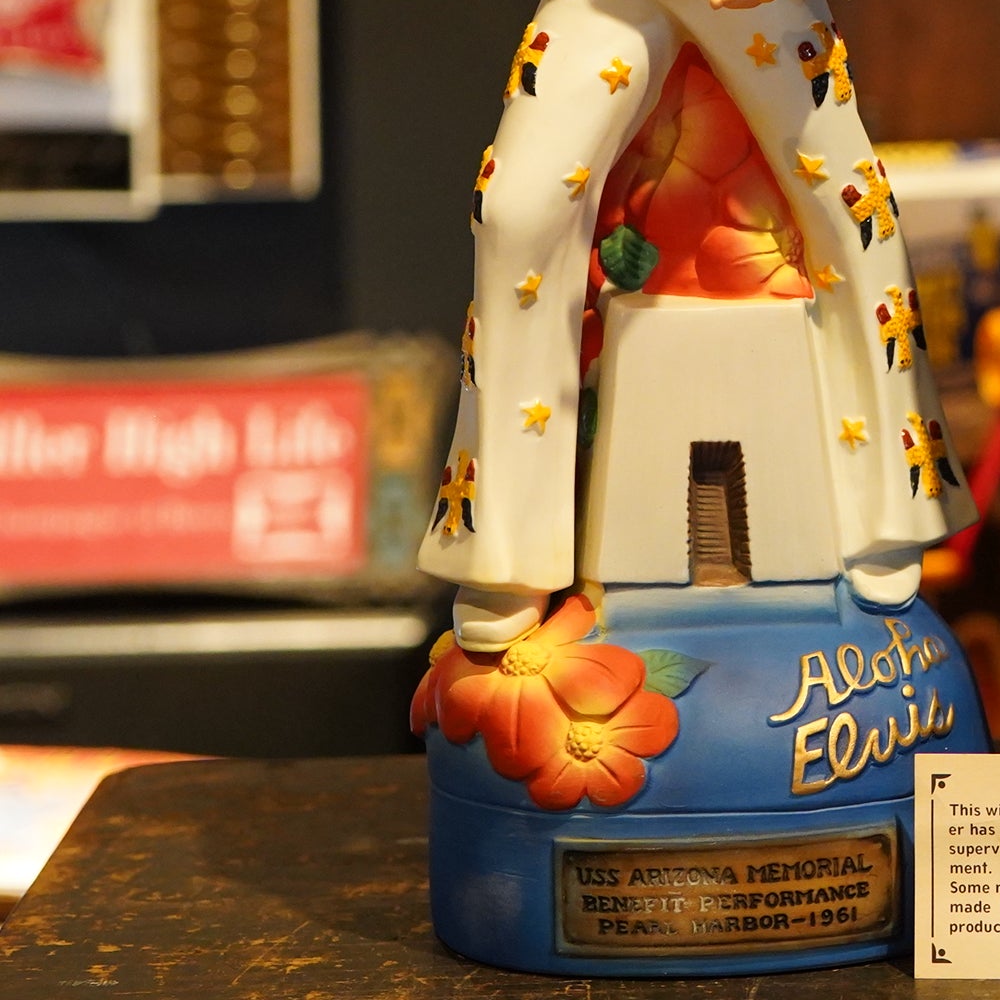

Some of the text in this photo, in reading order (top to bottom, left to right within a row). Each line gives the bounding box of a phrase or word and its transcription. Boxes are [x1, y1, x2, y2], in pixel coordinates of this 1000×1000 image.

[767, 617, 949, 724] Aloha
[790, 684, 955, 796] Elvis
[949, 803, 981, 817] This
[948, 824, 965, 836] er
[969, 823, 996, 836] has
[575, 853, 873, 888] USS ARIZONA MEMORIAL
[949, 861, 993, 875] ment.
[949, 881, 990, 894] Some
[581, 881, 870, 914] BENEFIT PERFORMANCE
[949, 900, 992, 914] made
[597, 917, 678, 936] PEARL
